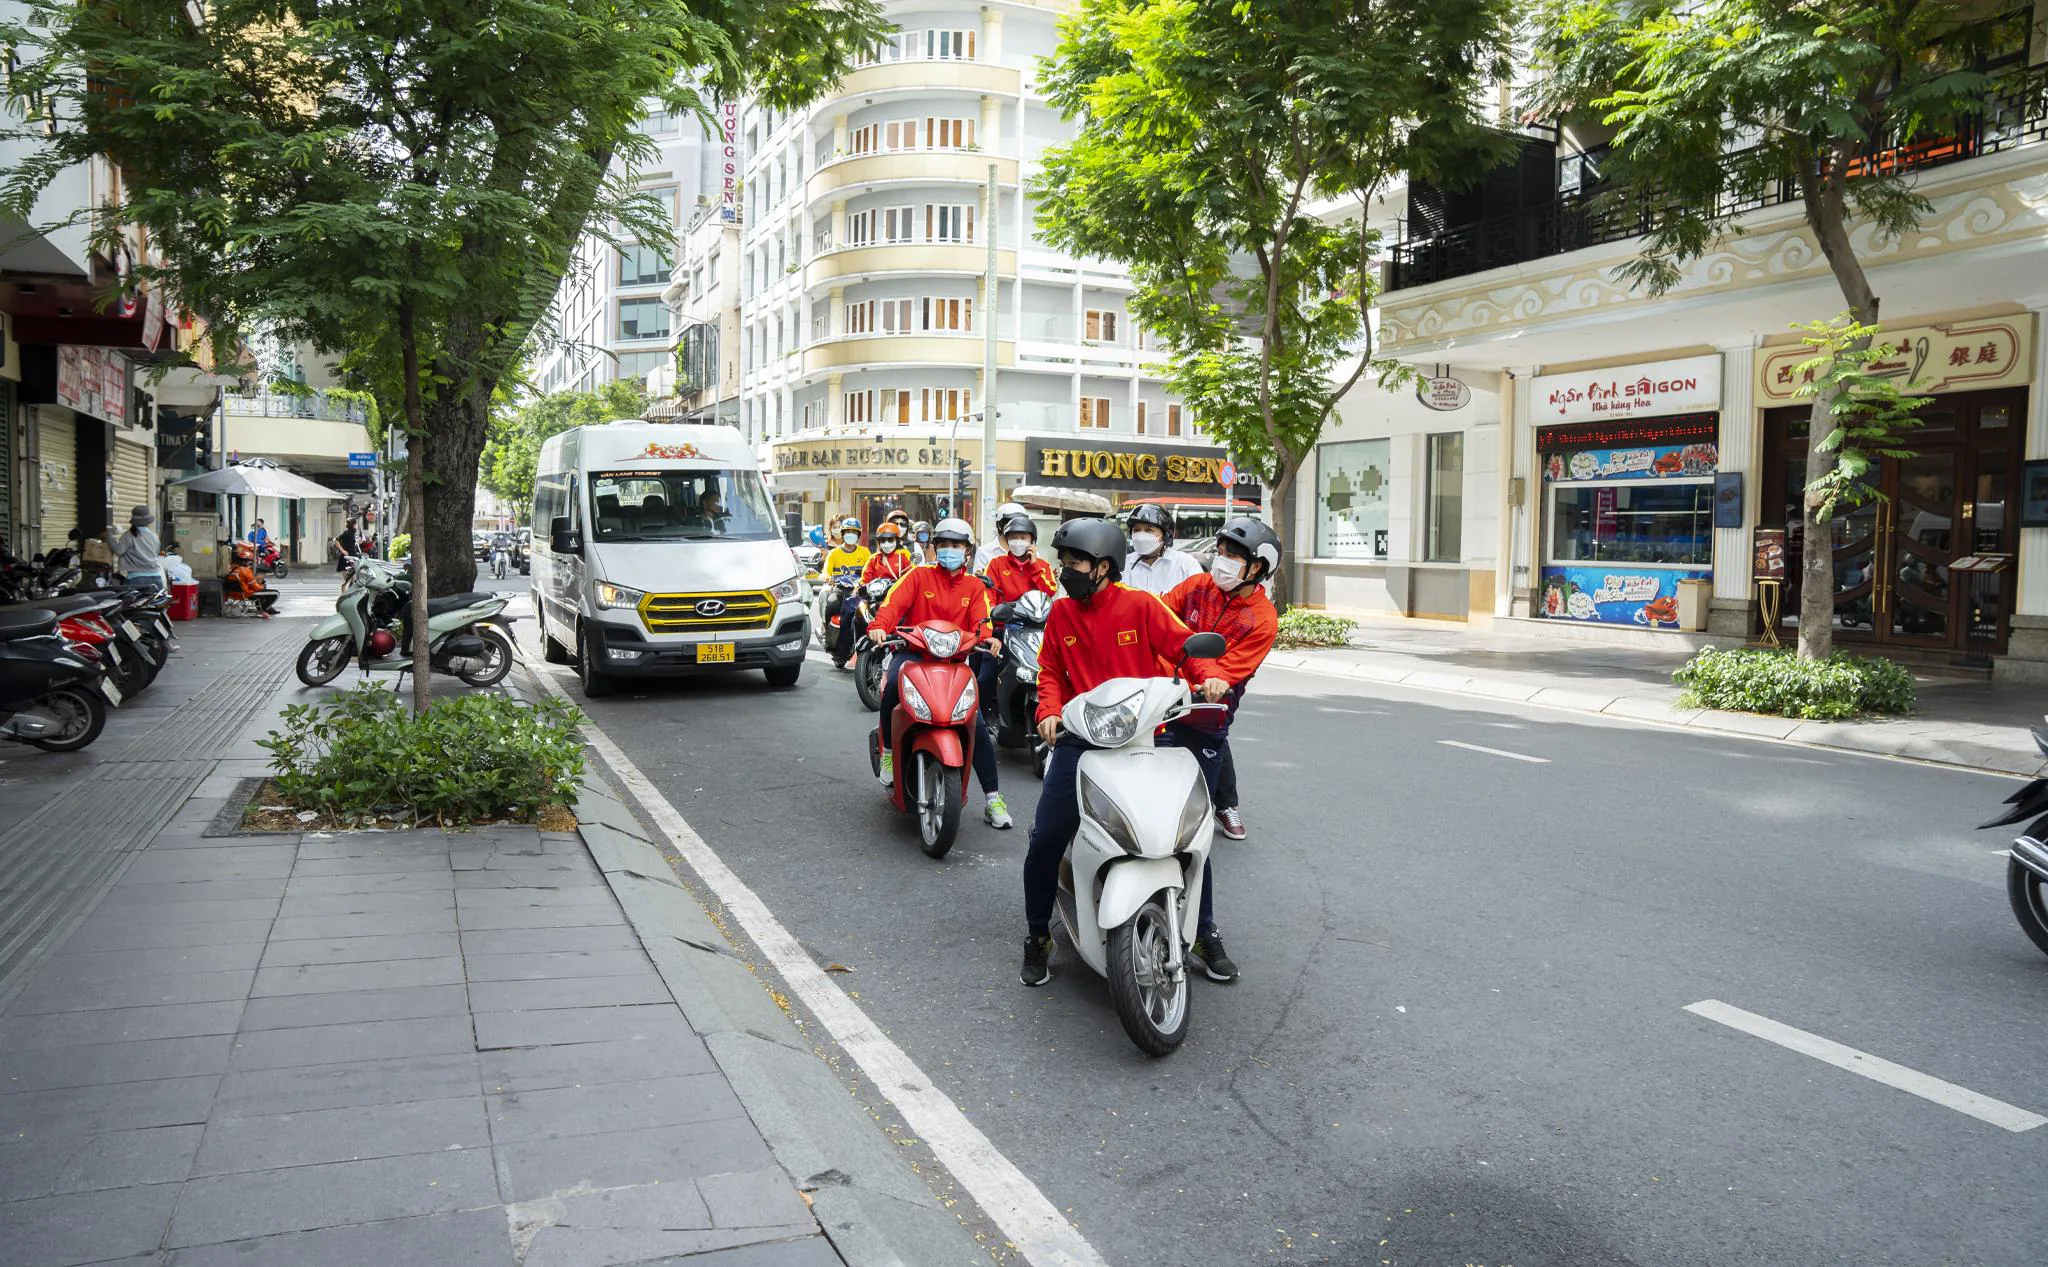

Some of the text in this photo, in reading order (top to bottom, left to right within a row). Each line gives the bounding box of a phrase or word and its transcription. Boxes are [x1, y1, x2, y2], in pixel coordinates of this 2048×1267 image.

[723, 163, 735, 204] SEN
[1949, 341, 2000, 367] 銀庭
[1611, 399, 1631, 411] hàng
[1634, 397, 1652, 408] Hoa
[1040, 448, 1226, 484] HUONG SEN
